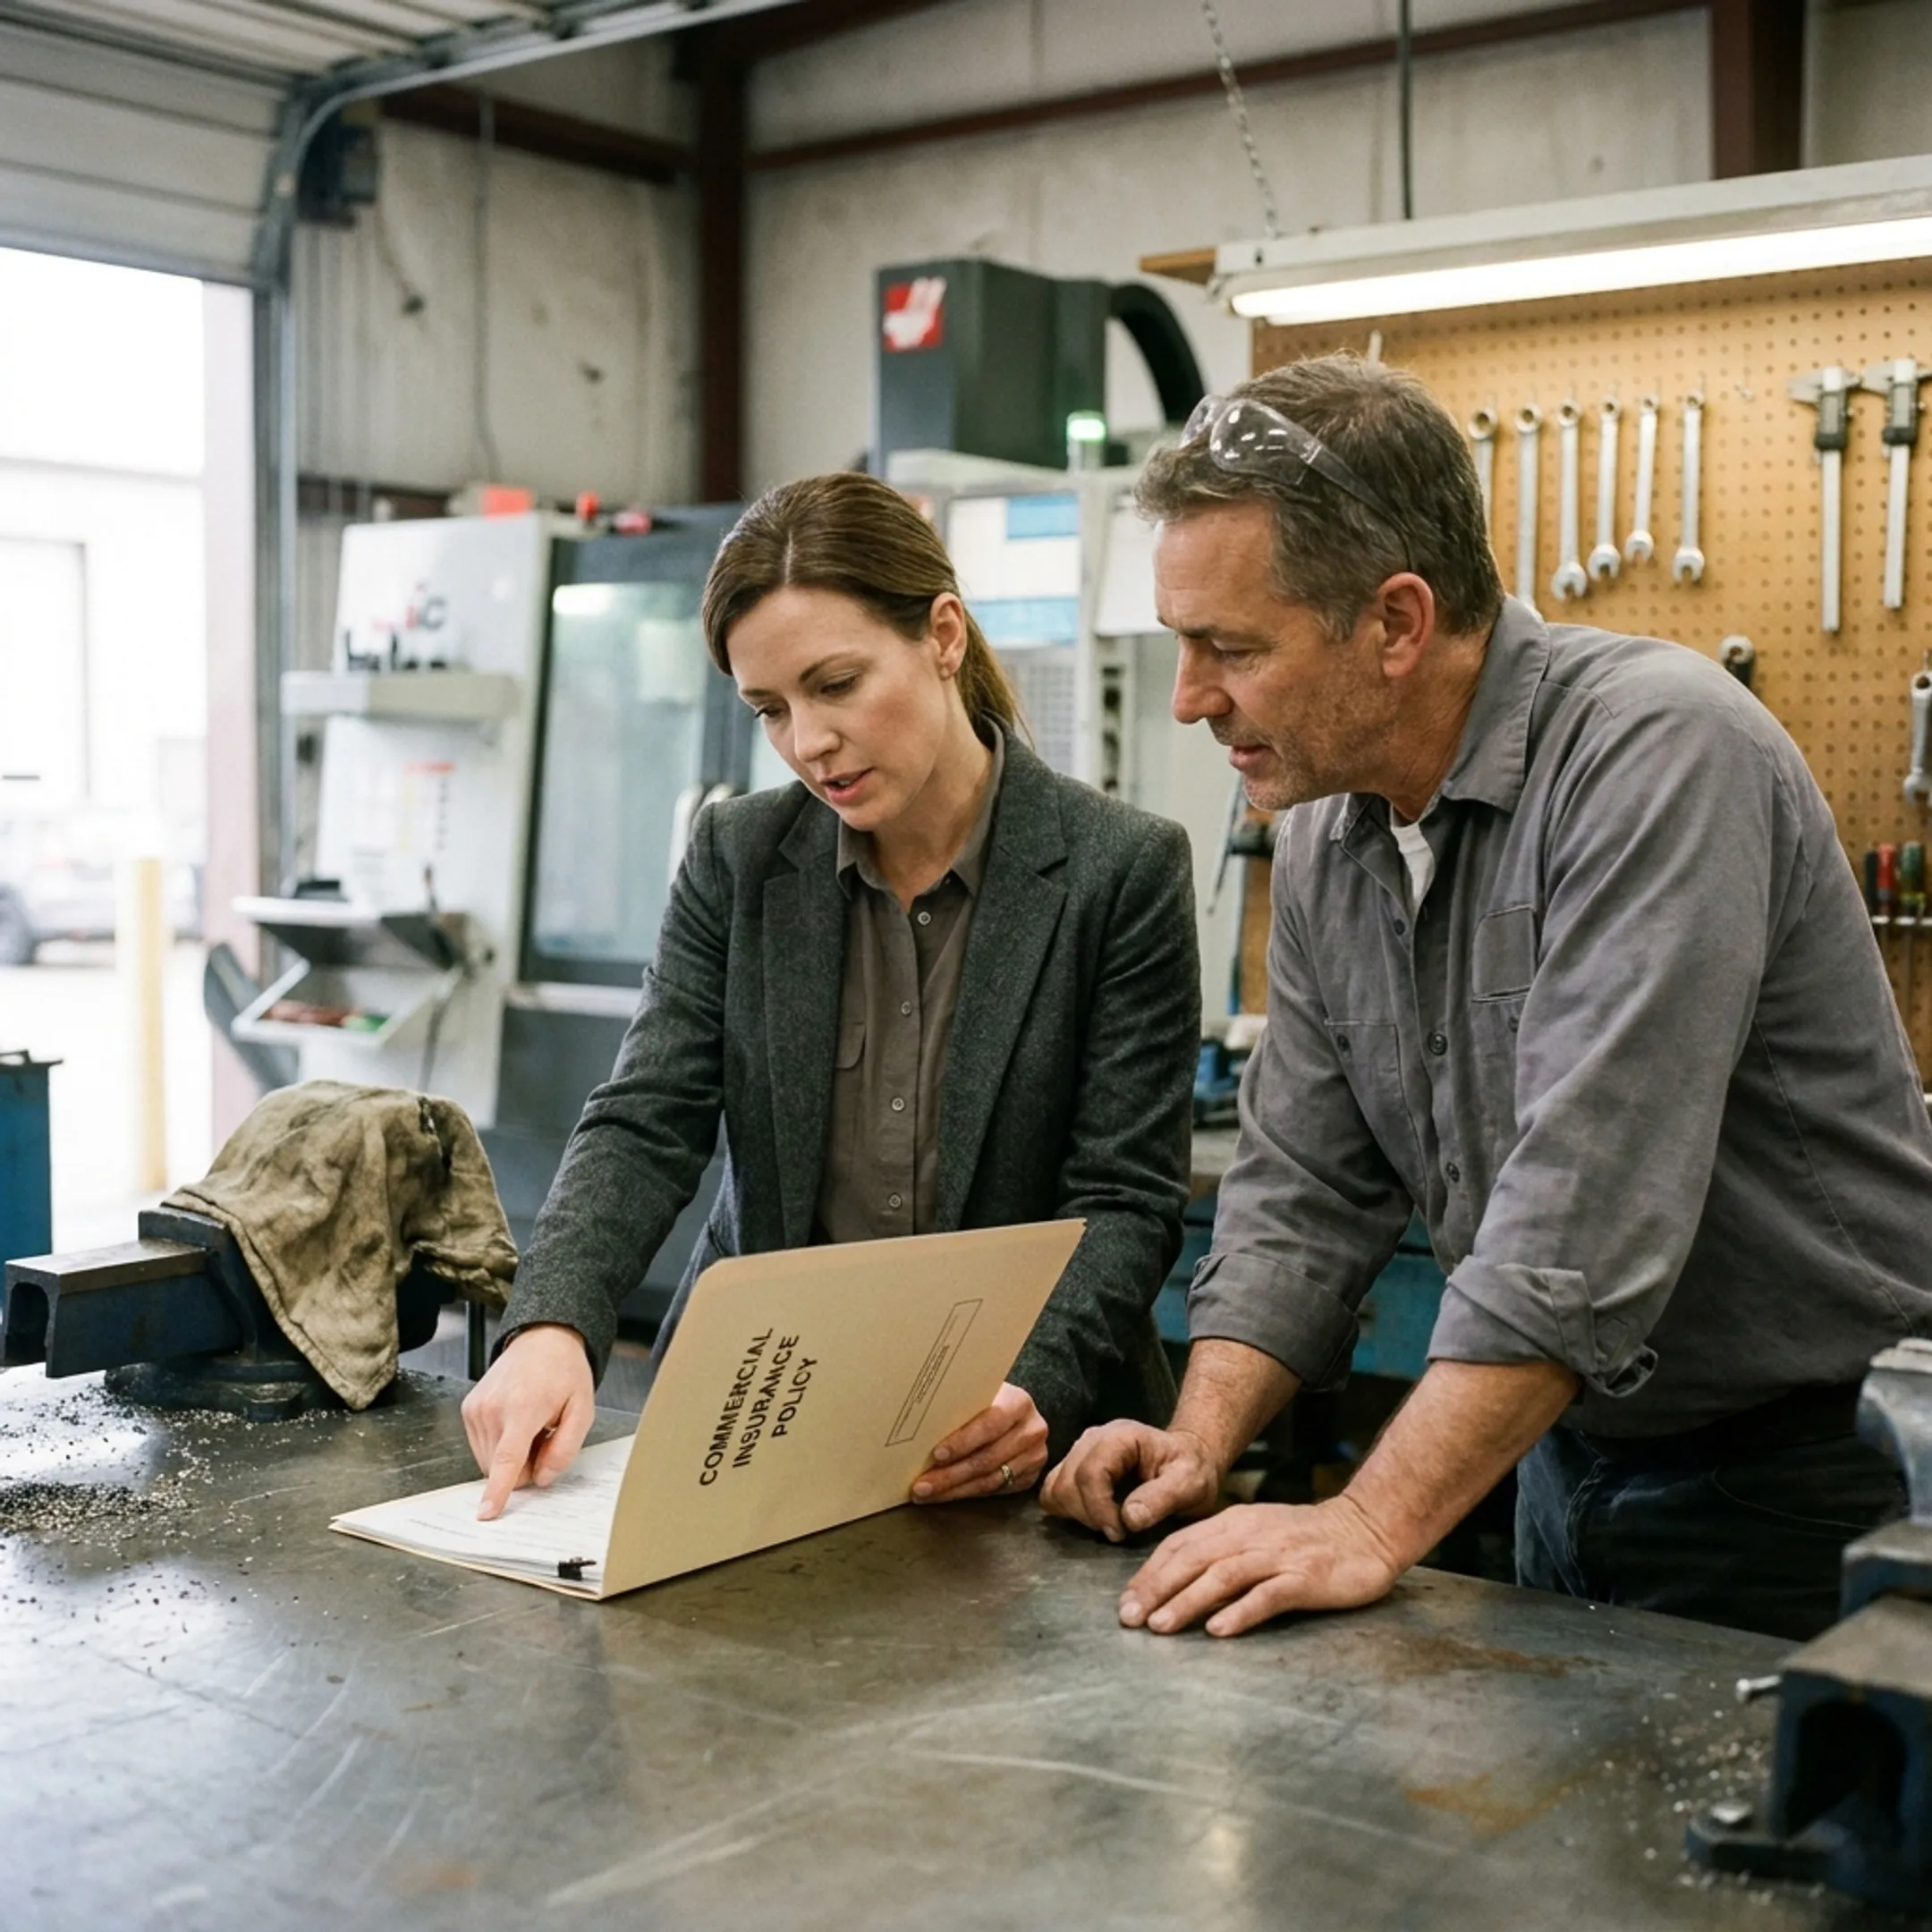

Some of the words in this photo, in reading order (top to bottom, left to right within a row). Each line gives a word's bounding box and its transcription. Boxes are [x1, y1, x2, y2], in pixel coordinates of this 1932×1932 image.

[699, 1327, 774, 1486] COMMERCIAL
[733, 1335, 800, 1469] INSURANCE
[770, 1358, 818, 1438] POLICY
